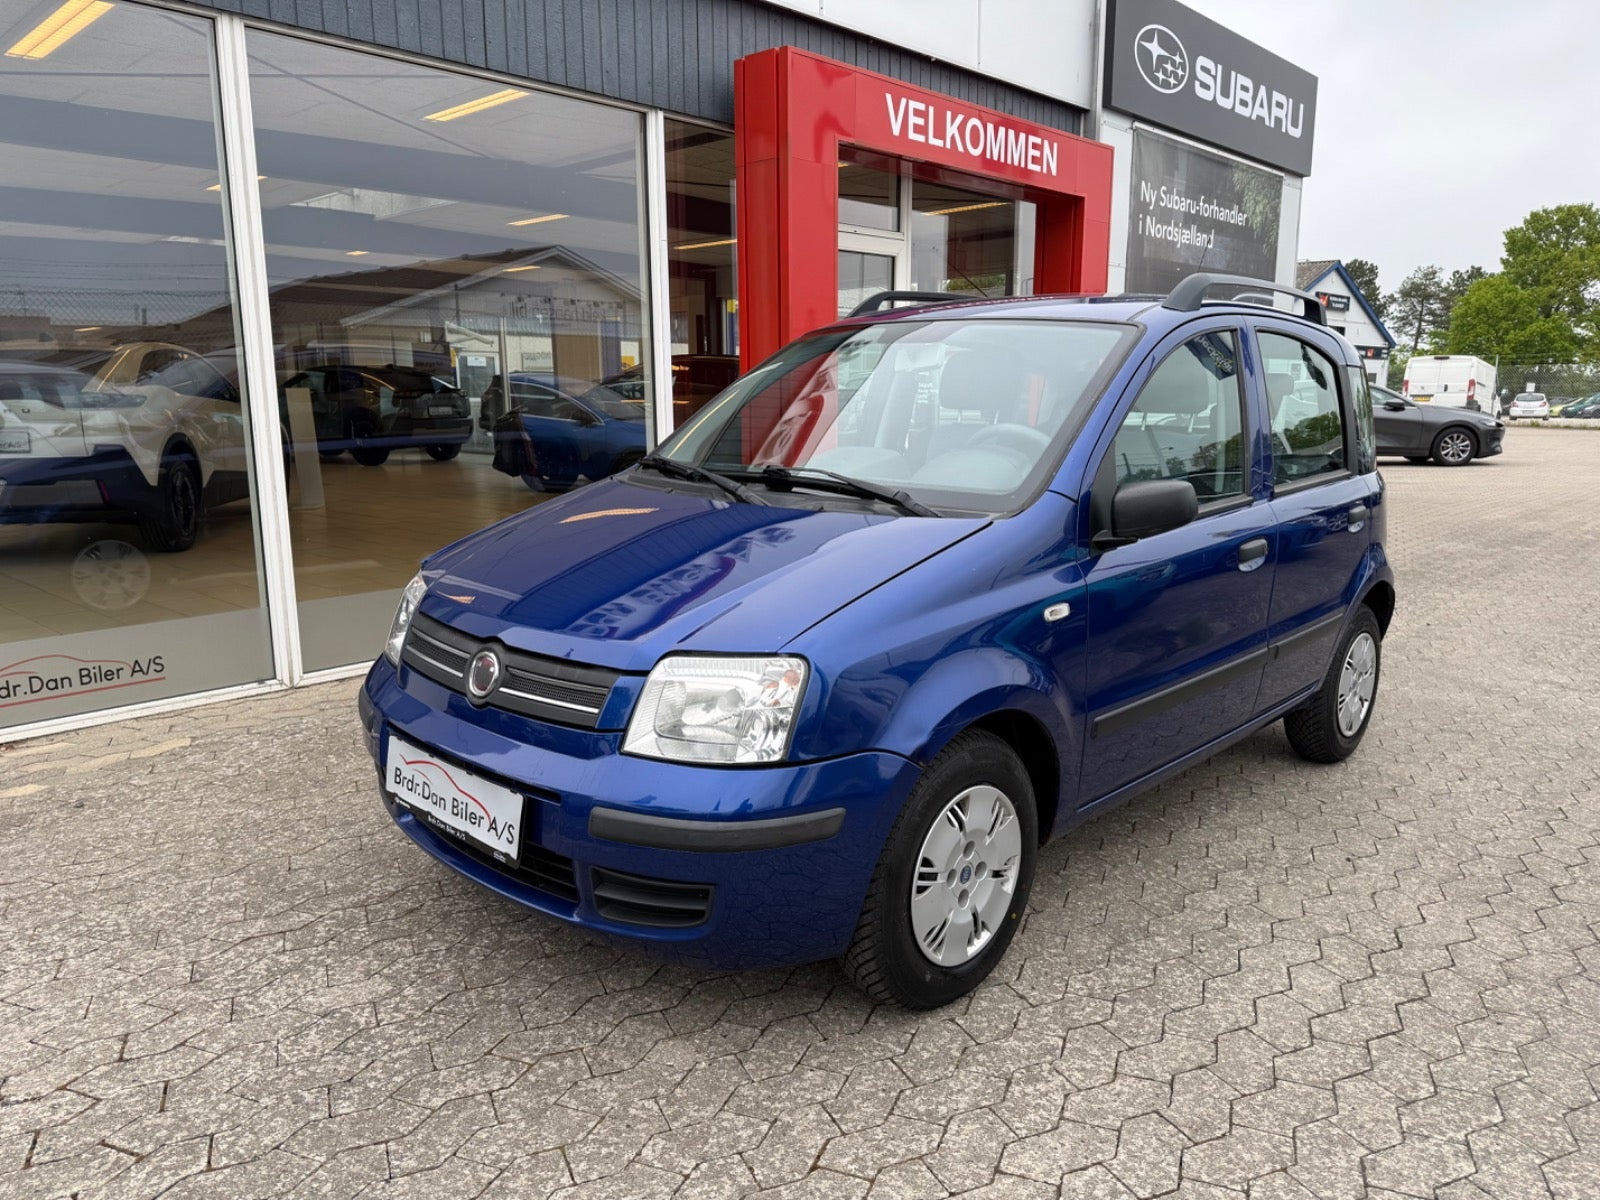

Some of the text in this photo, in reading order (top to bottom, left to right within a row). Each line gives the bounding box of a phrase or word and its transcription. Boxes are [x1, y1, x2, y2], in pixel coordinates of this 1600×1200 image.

[1194, 55, 1304, 139] SUBARU
[885, 92, 1058, 177] VELKOMMEN
[1138, 214, 1215, 249] i Nordsjælland
[1141, 180, 1248, 226] Ny Subaru-forhandler
[78, 665, 125, 686] Biler
[130, 655, 166, 678] A/S
[394, 766, 447, 811] Brdr.Dan
[451, 797, 485, 828] Biler
[487, 816, 515, 846] A/S
